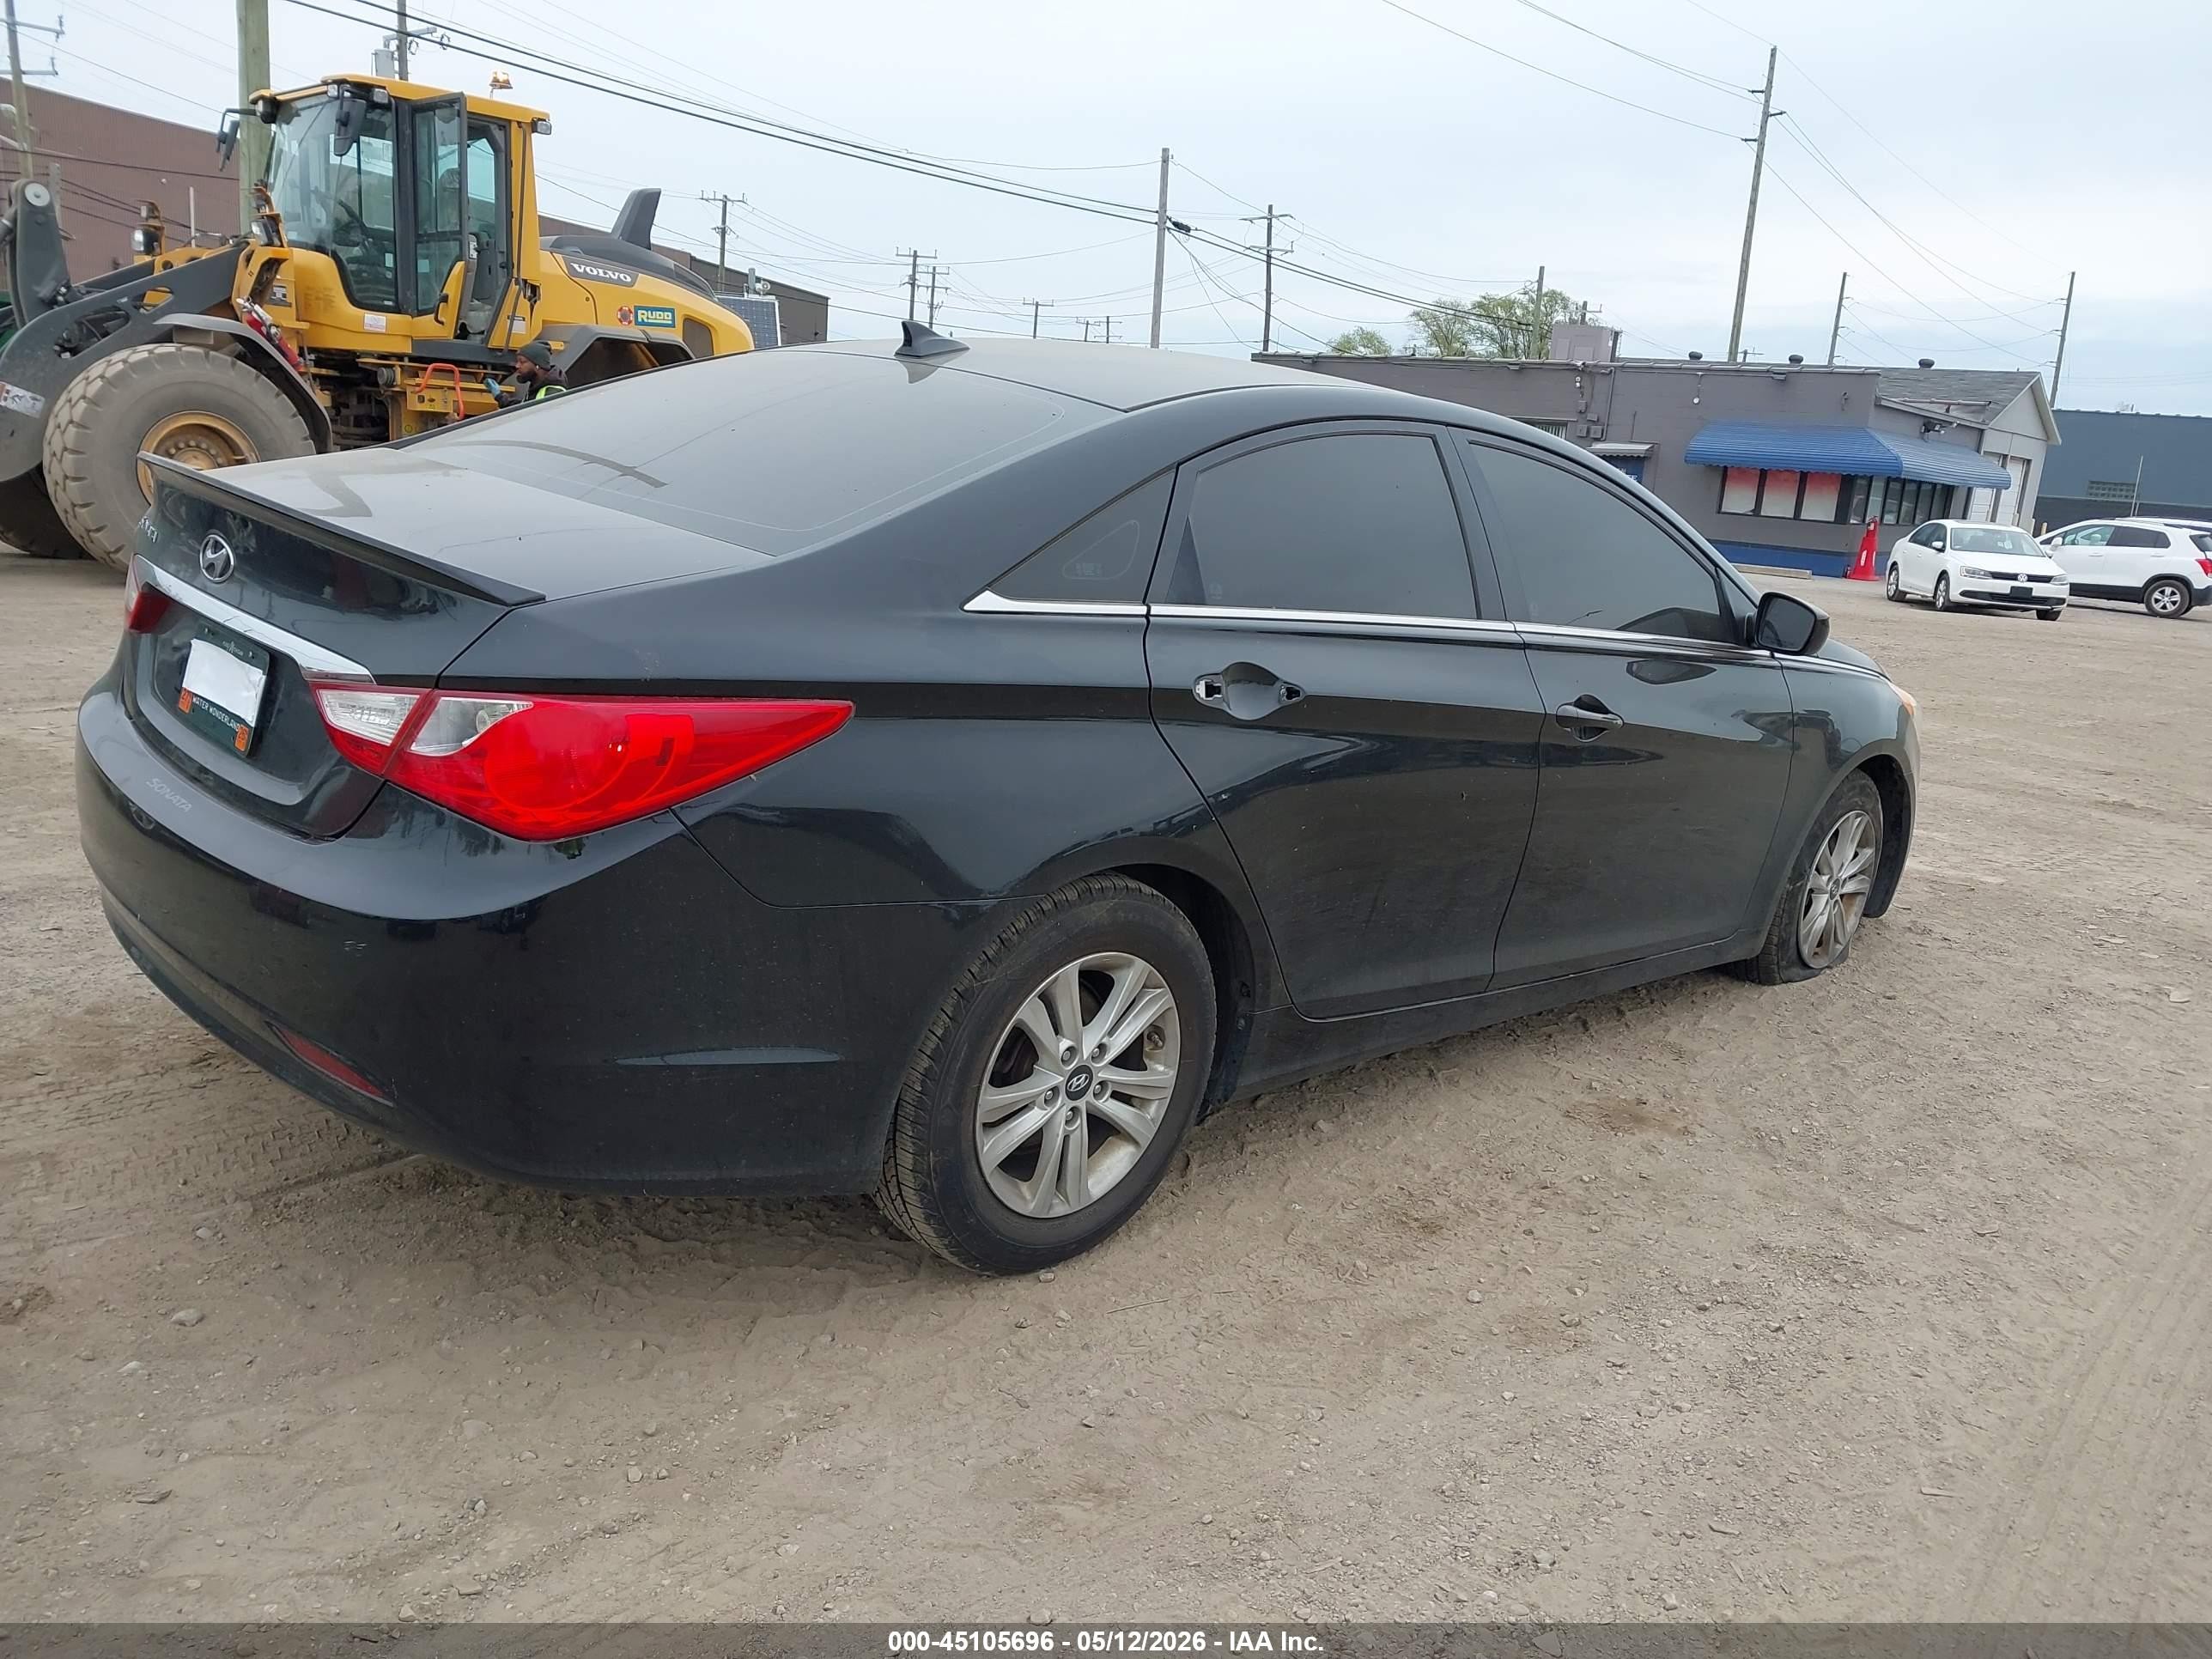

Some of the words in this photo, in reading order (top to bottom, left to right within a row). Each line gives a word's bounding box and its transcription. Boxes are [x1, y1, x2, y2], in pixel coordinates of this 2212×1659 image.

[570, 262, 632, 283] VOLVO
[637, 309, 672, 324] RUDD
[192, 695, 210, 711] WATER
[209, 706, 240, 732] WONDERLAND
[146, 778, 192, 812] SONATA
